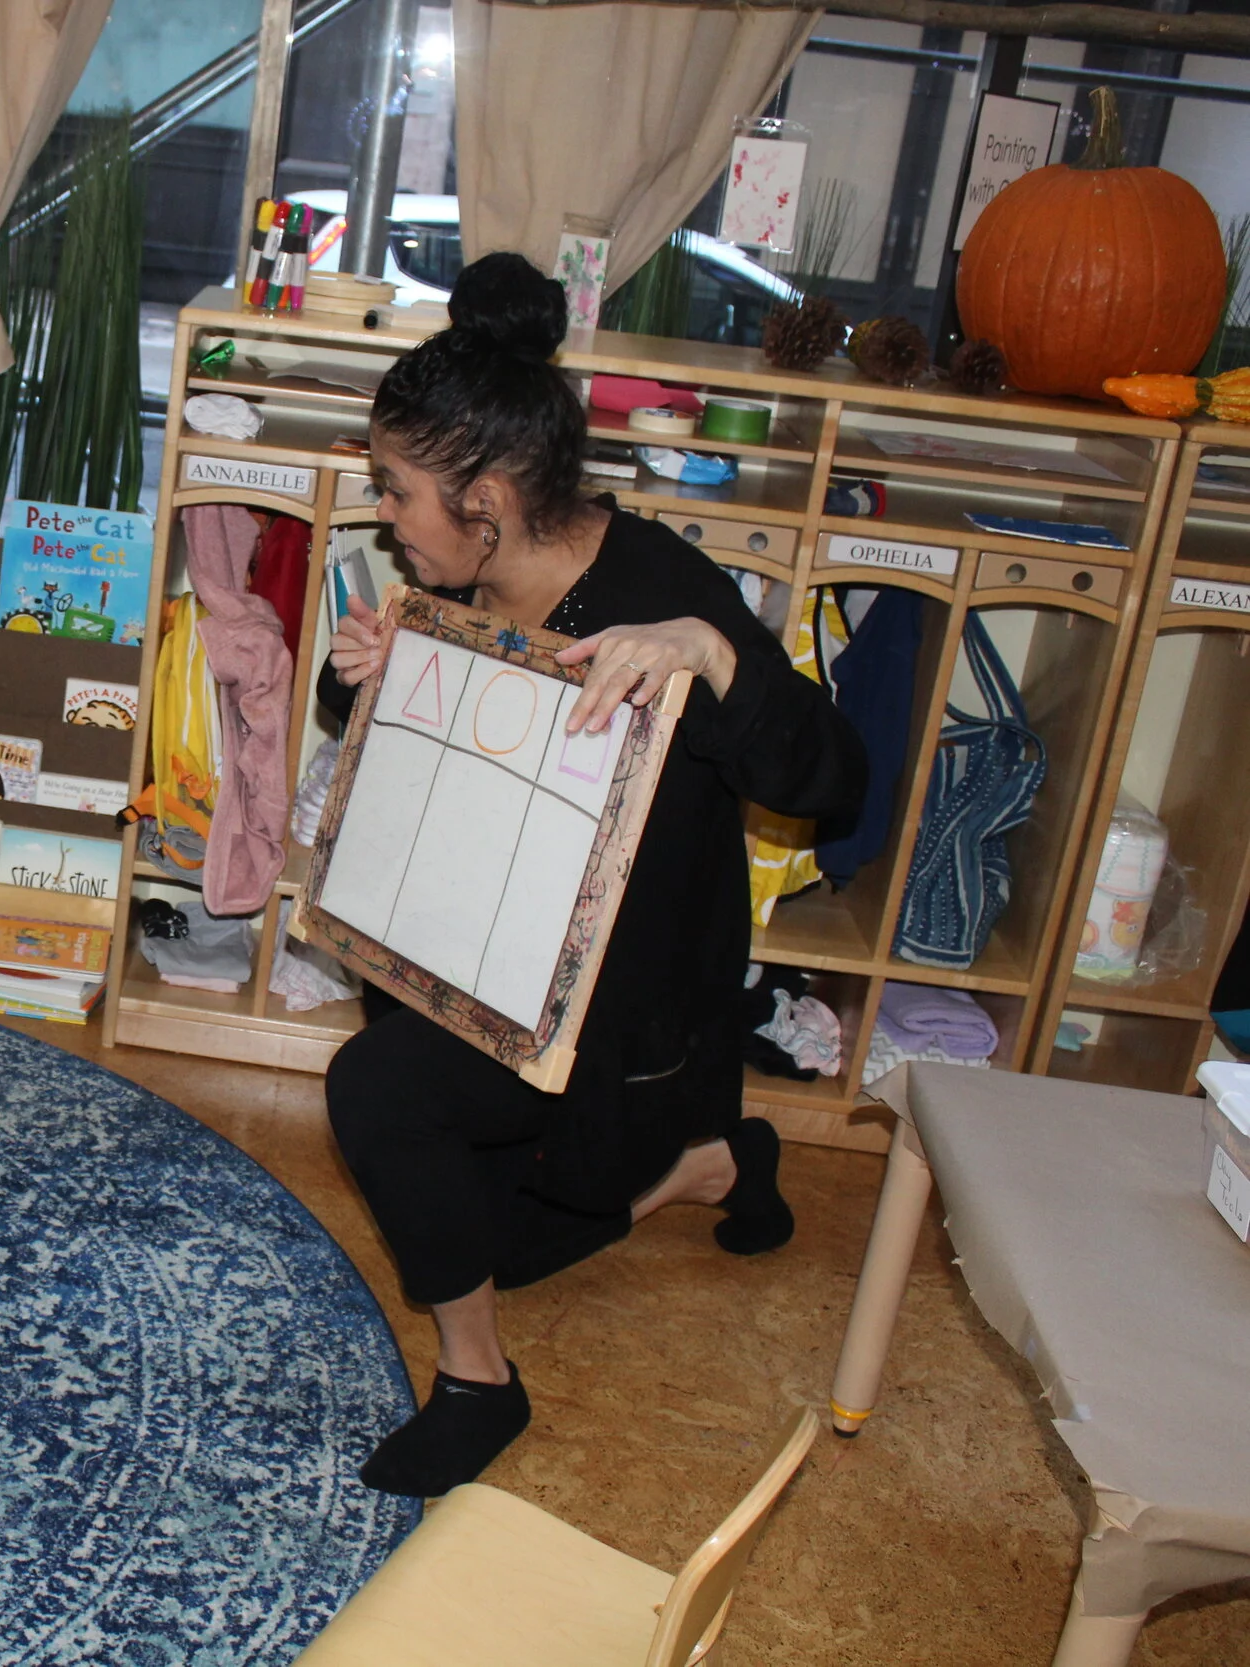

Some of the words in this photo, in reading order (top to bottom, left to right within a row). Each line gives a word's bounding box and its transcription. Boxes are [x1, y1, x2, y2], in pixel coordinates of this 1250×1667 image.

[983, 133, 1037, 172] Painting
[969, 176, 996, 205] with
[190, 463, 306, 490] ANNABELLE
[26, 505, 76, 533] Pete
[77, 514, 93, 525] the
[93, 515, 136, 541] Cat
[32, 534, 76, 560] Pete
[76, 543, 91, 553] the
[90, 543, 127, 567] Cat
[850, 544, 934, 568] OPHELIA
[66, 687, 99, 707] PETE'S
[101, 688, 110, 697] A
[69, 871, 109, 898] STONE
